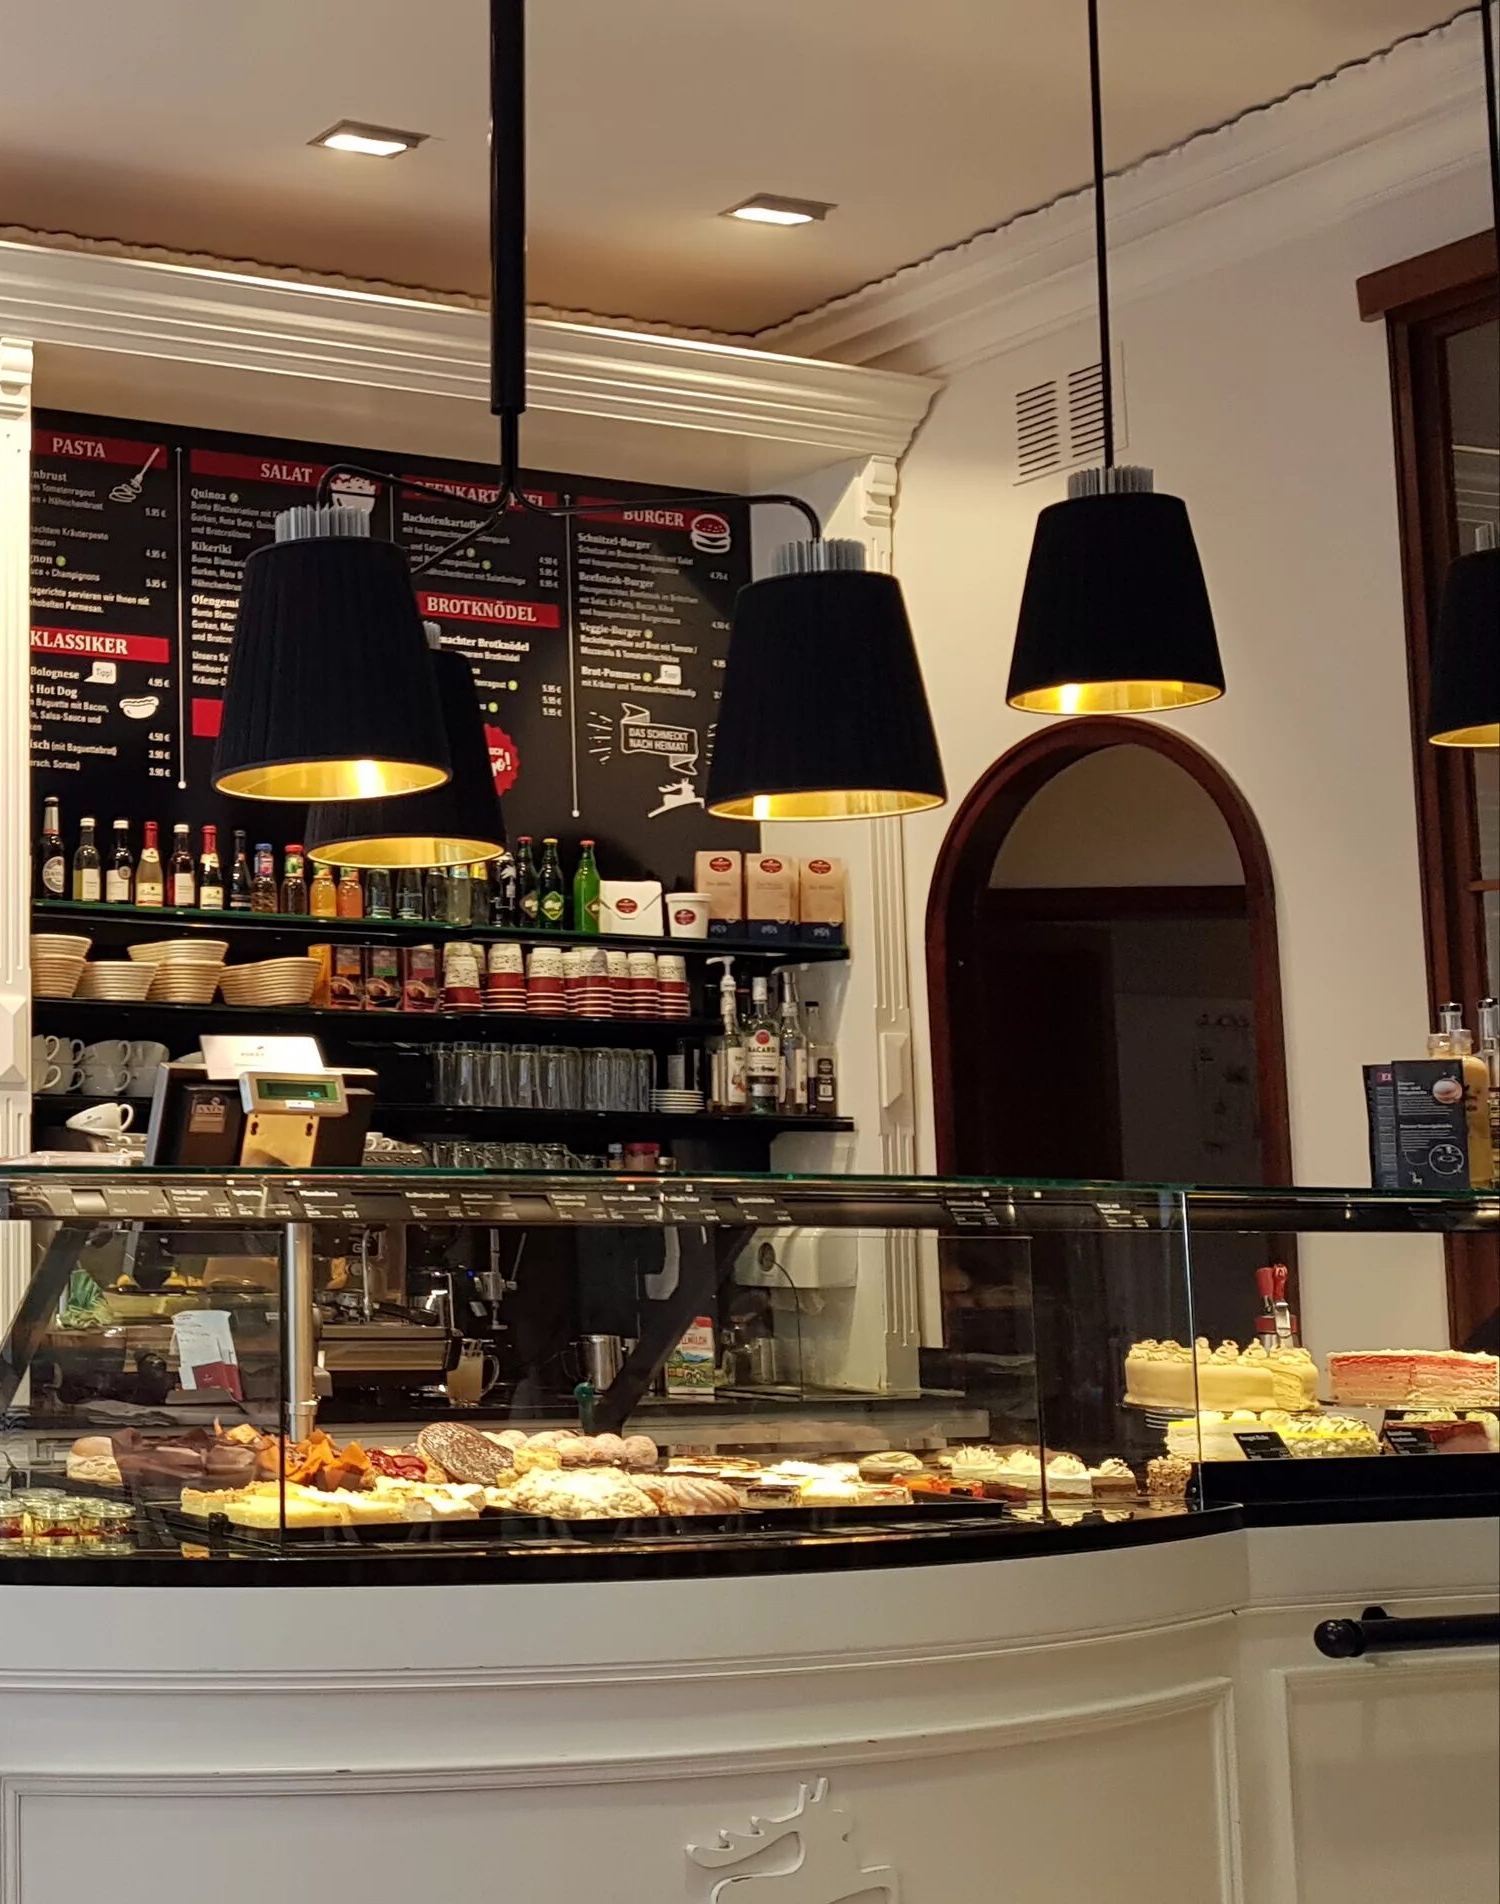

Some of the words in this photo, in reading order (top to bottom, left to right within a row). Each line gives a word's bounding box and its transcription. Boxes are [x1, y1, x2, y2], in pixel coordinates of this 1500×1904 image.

[53, 438, 105, 457] PASTA
[261, 463, 312, 482] SALAT
[191, 488, 226, 500] Quinoa
[428, 597, 536, 621] BROTKNÖDEL
[30, 666, 79, 679] Bolognese
[37, 684, 54, 694] Hot
[57, 686, 77, 699] Dog
[629, 728, 645, 737] DAS
[647, 729, 688, 740] SCHMECKT
